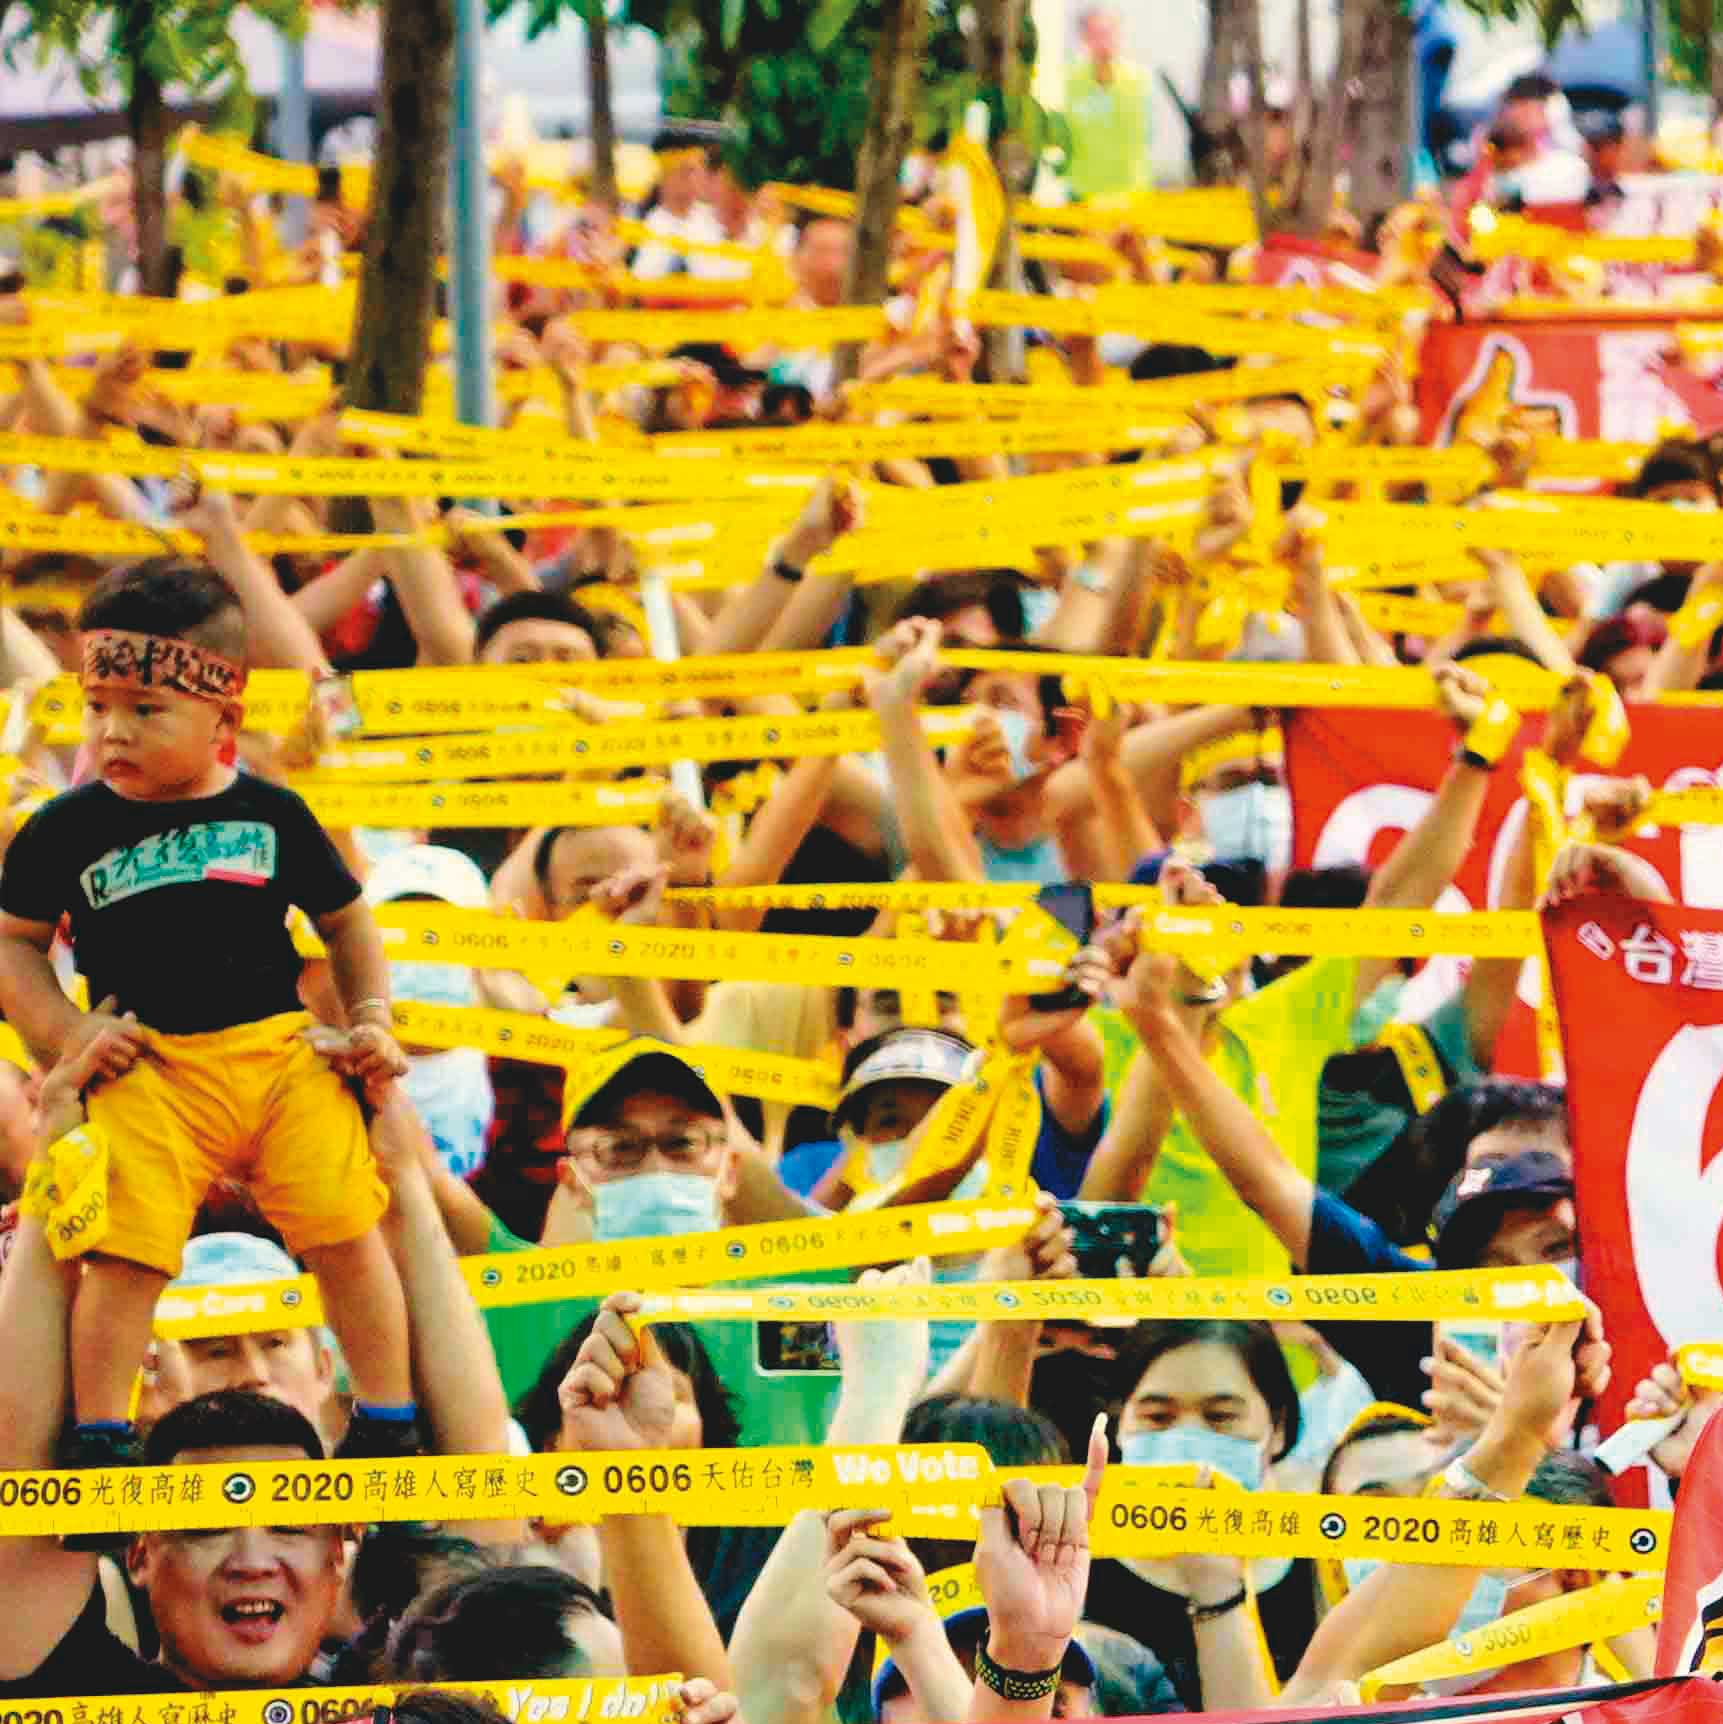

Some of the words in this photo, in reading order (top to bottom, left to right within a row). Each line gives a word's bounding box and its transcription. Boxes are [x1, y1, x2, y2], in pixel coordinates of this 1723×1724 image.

[515, 1260, 577, 1283] 2020
[759, 1232, 824, 1256] 0606
[0, 1478, 82, 1506] 0606
[90, 1473, 204, 1505] 光復高雄
[271, 1473, 353, 1503] 2020
[362, 1466, 538, 1503] 高雄人寫歷史
[603, 1462, 691, 1494] 0606
[703, 1457, 814, 1492] 天佑台灣
[834, 1453, 892, 1484] We
[898, 1452, 980, 1481] Vote
[1111, 1503, 1188, 1532] 0606
[1197, 1505, 1302, 1538] 光復高雄
[1362, 1514, 1439, 1544] 2020
[1450, 1516, 1612, 1555] 高雄人寫歷史
[508, 1686, 570, 1721] Yes
